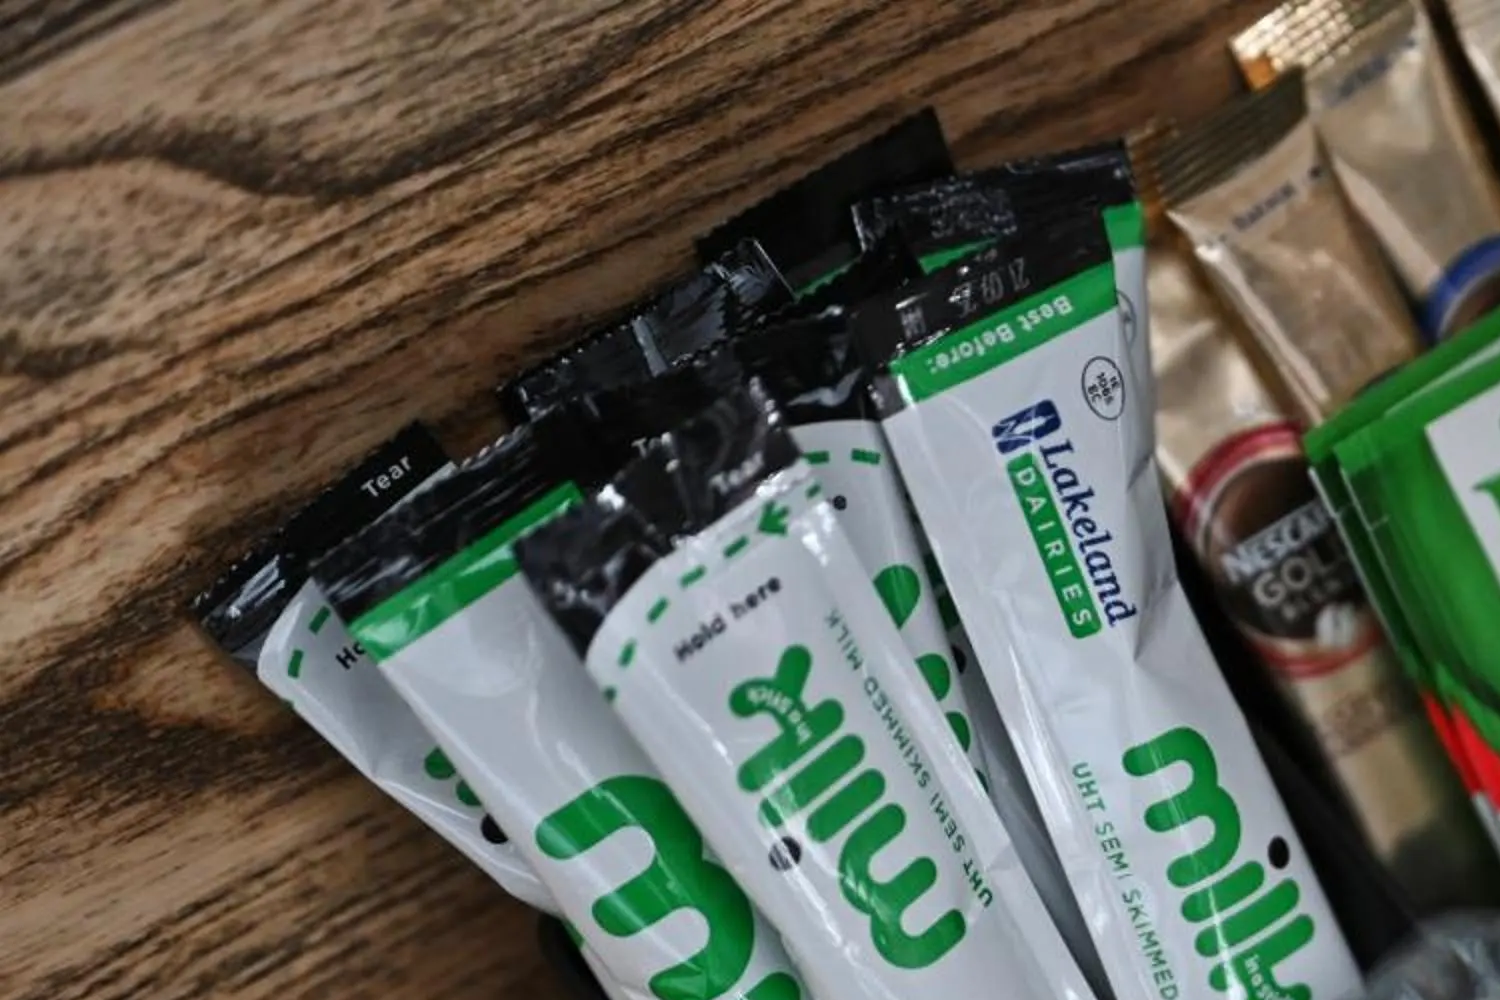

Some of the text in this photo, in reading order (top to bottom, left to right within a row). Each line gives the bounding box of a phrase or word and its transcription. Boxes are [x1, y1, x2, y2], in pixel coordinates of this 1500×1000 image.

[1016, 294, 1074, 332] Best
[360, 454, 413, 500] Tear
[1039, 438, 1137, 628] Lakeland
[1015, 469, 1094, 627] DAIRIES
[673, 576, 783, 664] Hold here
[729, 644, 967, 970] milk
[823, 605, 994, 909] UHT SEMI SKIMMED MILK
[1072, 761, 1107, 814] UHT
[1095, 822, 1132, 882] SEMI
